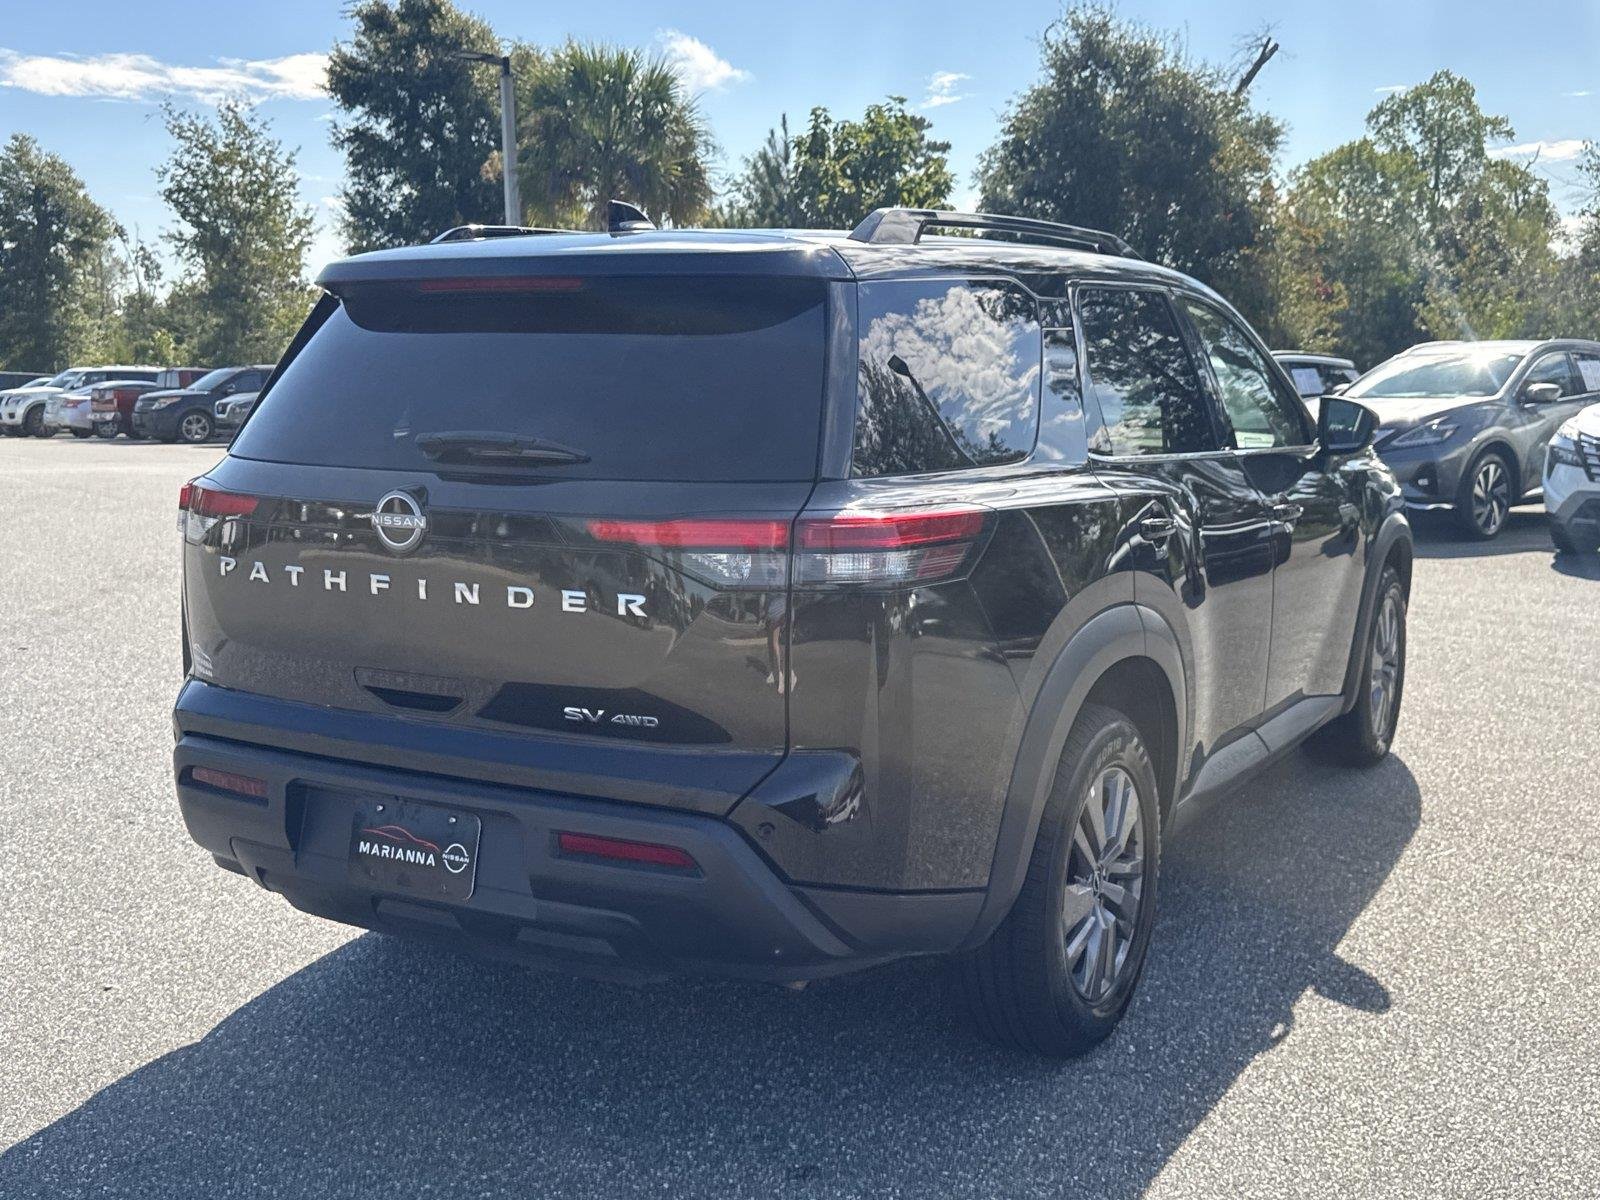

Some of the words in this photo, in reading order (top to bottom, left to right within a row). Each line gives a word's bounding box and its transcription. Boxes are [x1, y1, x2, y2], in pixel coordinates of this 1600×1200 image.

[371, 514, 424, 527] NISSAN
[219, 556, 648, 618] PATHFINDER
[563, 706, 605, 723] SV
[611, 714, 659, 728] 4WD
[359, 841, 436, 867] MARIANNA
[442, 853, 470, 864] NISSAN
